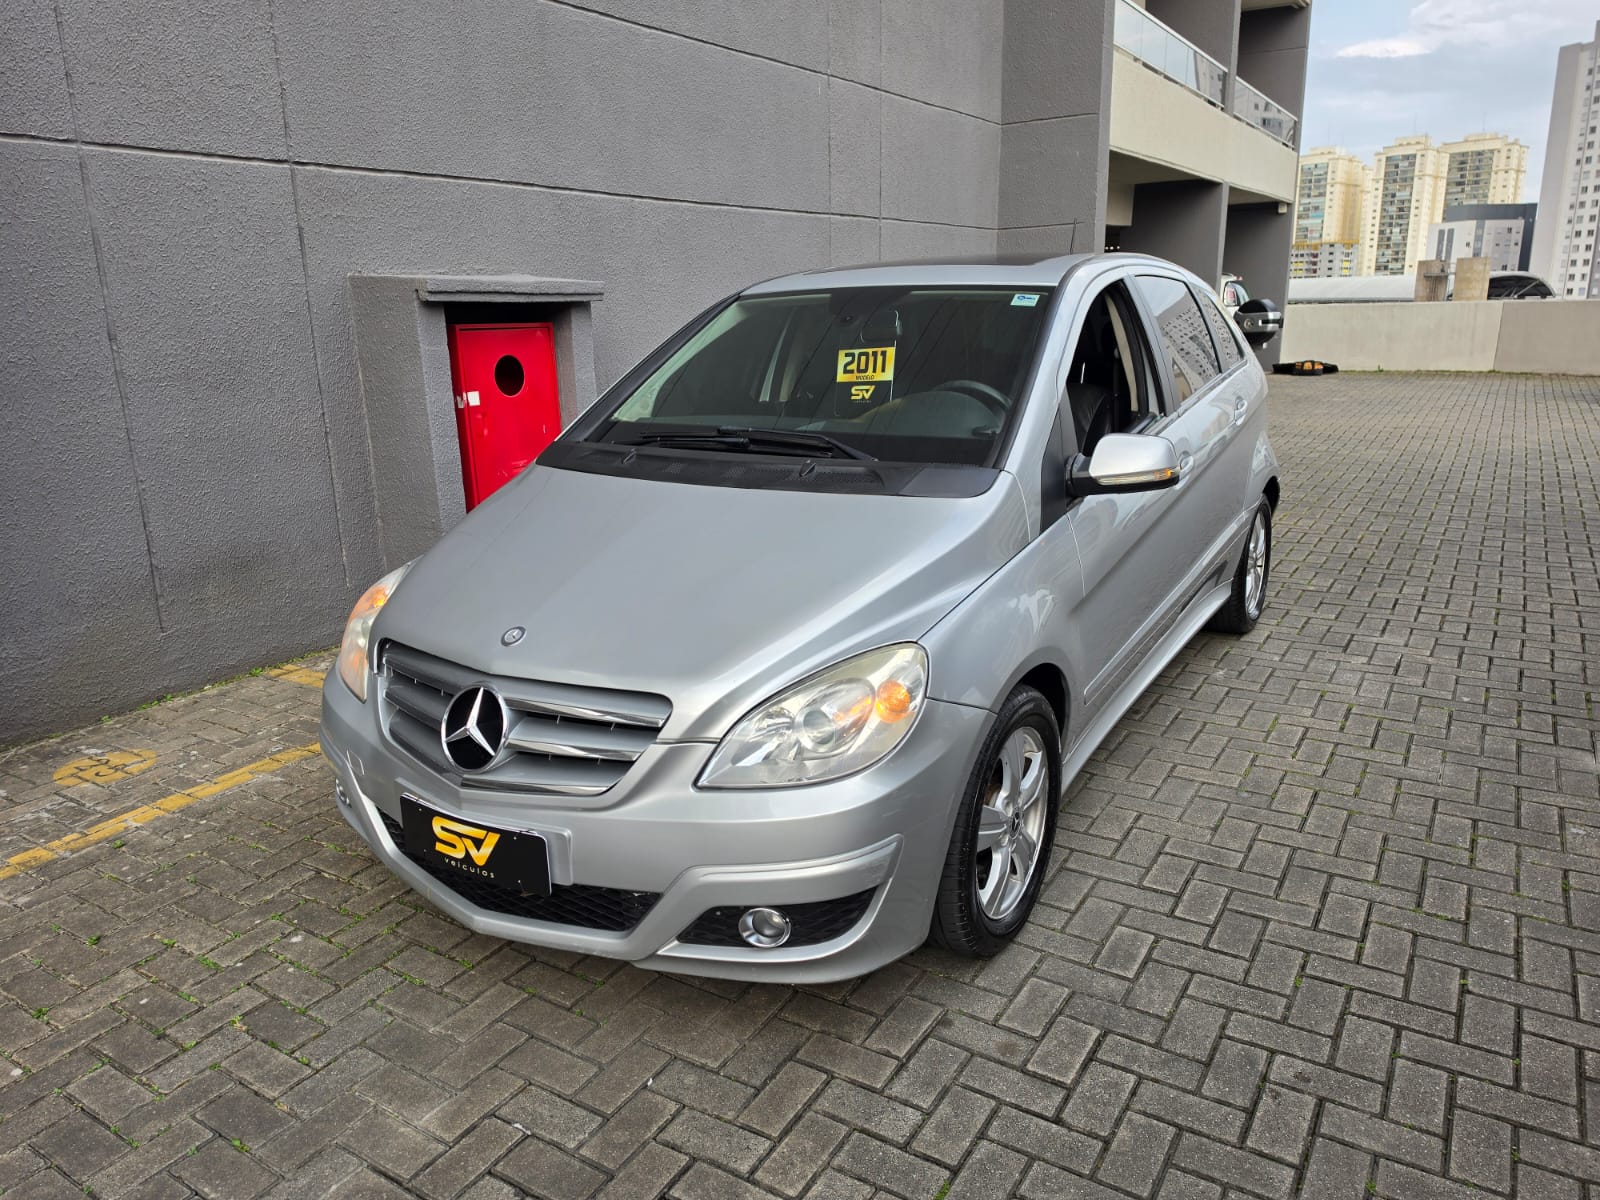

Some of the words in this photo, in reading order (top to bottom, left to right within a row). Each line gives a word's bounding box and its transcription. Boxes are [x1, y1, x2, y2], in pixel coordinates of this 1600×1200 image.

[843, 350, 887, 375] 2011
[850, 385, 876, 400] SV
[431, 815, 501, 866] SV
